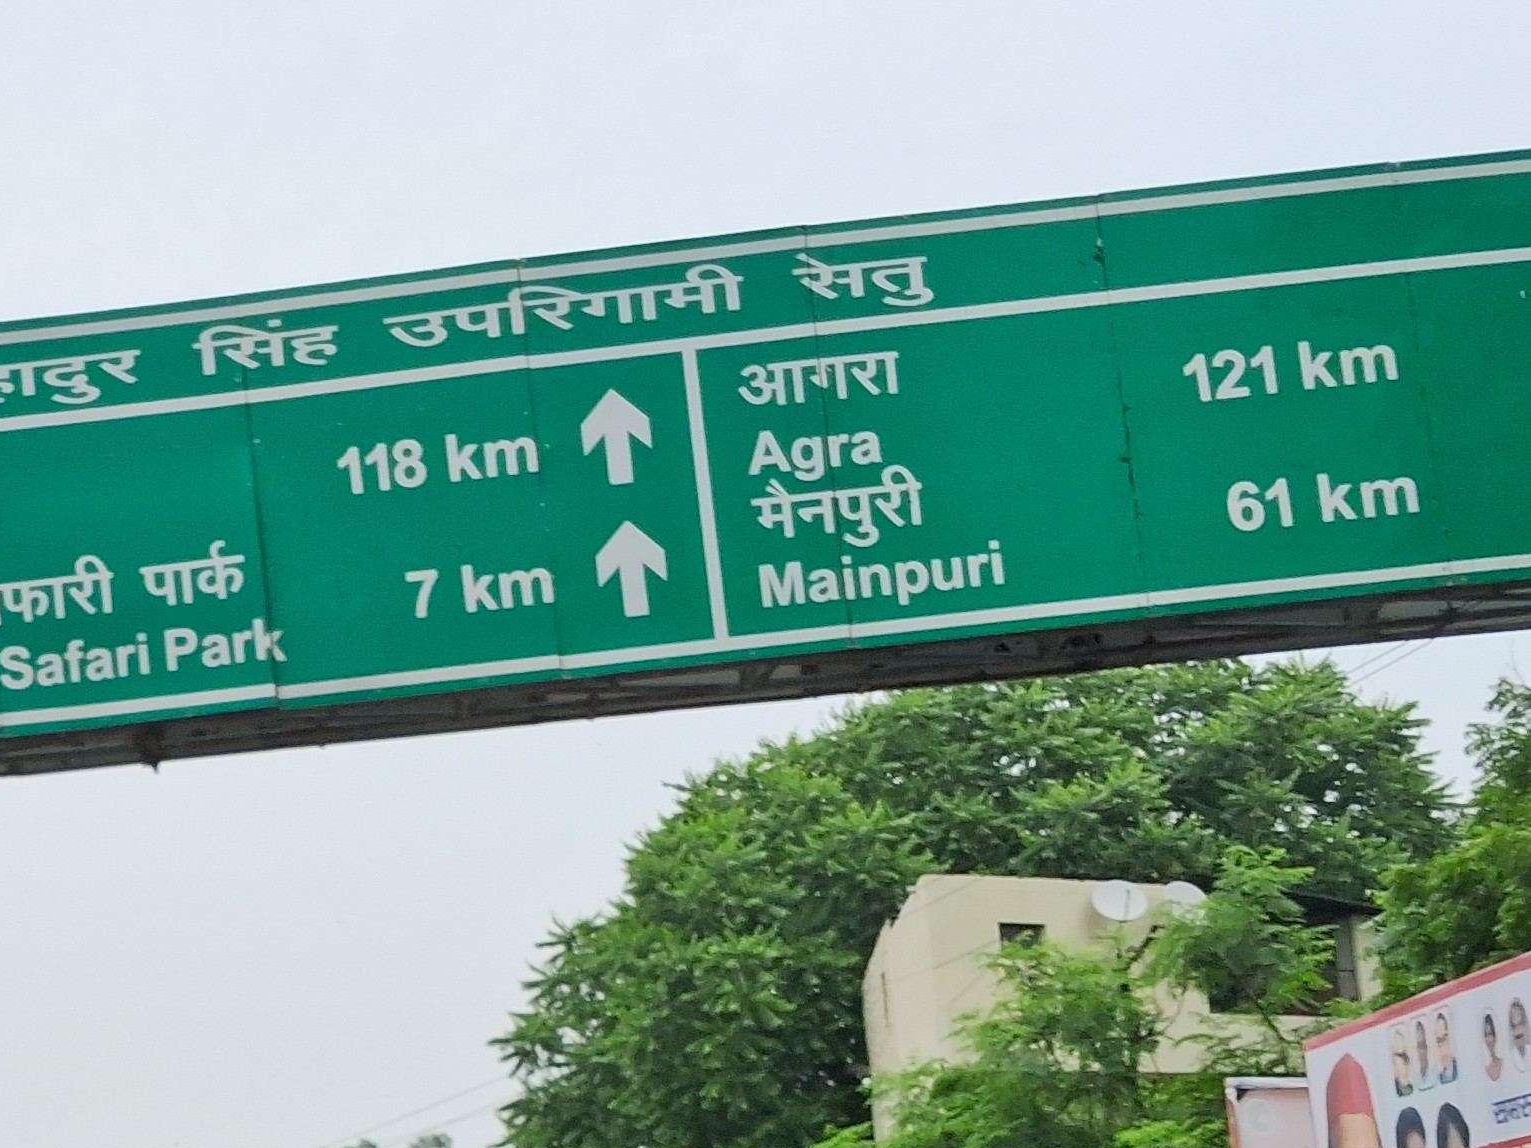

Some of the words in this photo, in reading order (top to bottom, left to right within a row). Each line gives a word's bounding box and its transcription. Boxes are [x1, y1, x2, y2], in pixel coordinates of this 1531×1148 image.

[193, 319, 339, 376] सिंह
[384, 264, 744, 347] उपरिगामी
[793, 253, 935, 307] सेतु
[738, 350, 900, 405] आगरा
[1183, 346, 1278, 402] 121
[1298, 342, 1398, 390] km
[337, 440, 427, 494] 118
[446, 434, 539, 482] km
[748, 430, 882, 482] Agra
[750, 464, 923, 547] मैनपुरी
[1227, 478, 1294, 532] 61
[1317, 473, 1420, 522] km
[140, 541, 246, 606] पार्क
[405, 569, 438, 618] 7
[462, 564, 555, 612] km
[758, 541, 1006, 608] Mainpuri
[0, 631, 152, 690] Safari
[165, 618, 287, 672] Park
